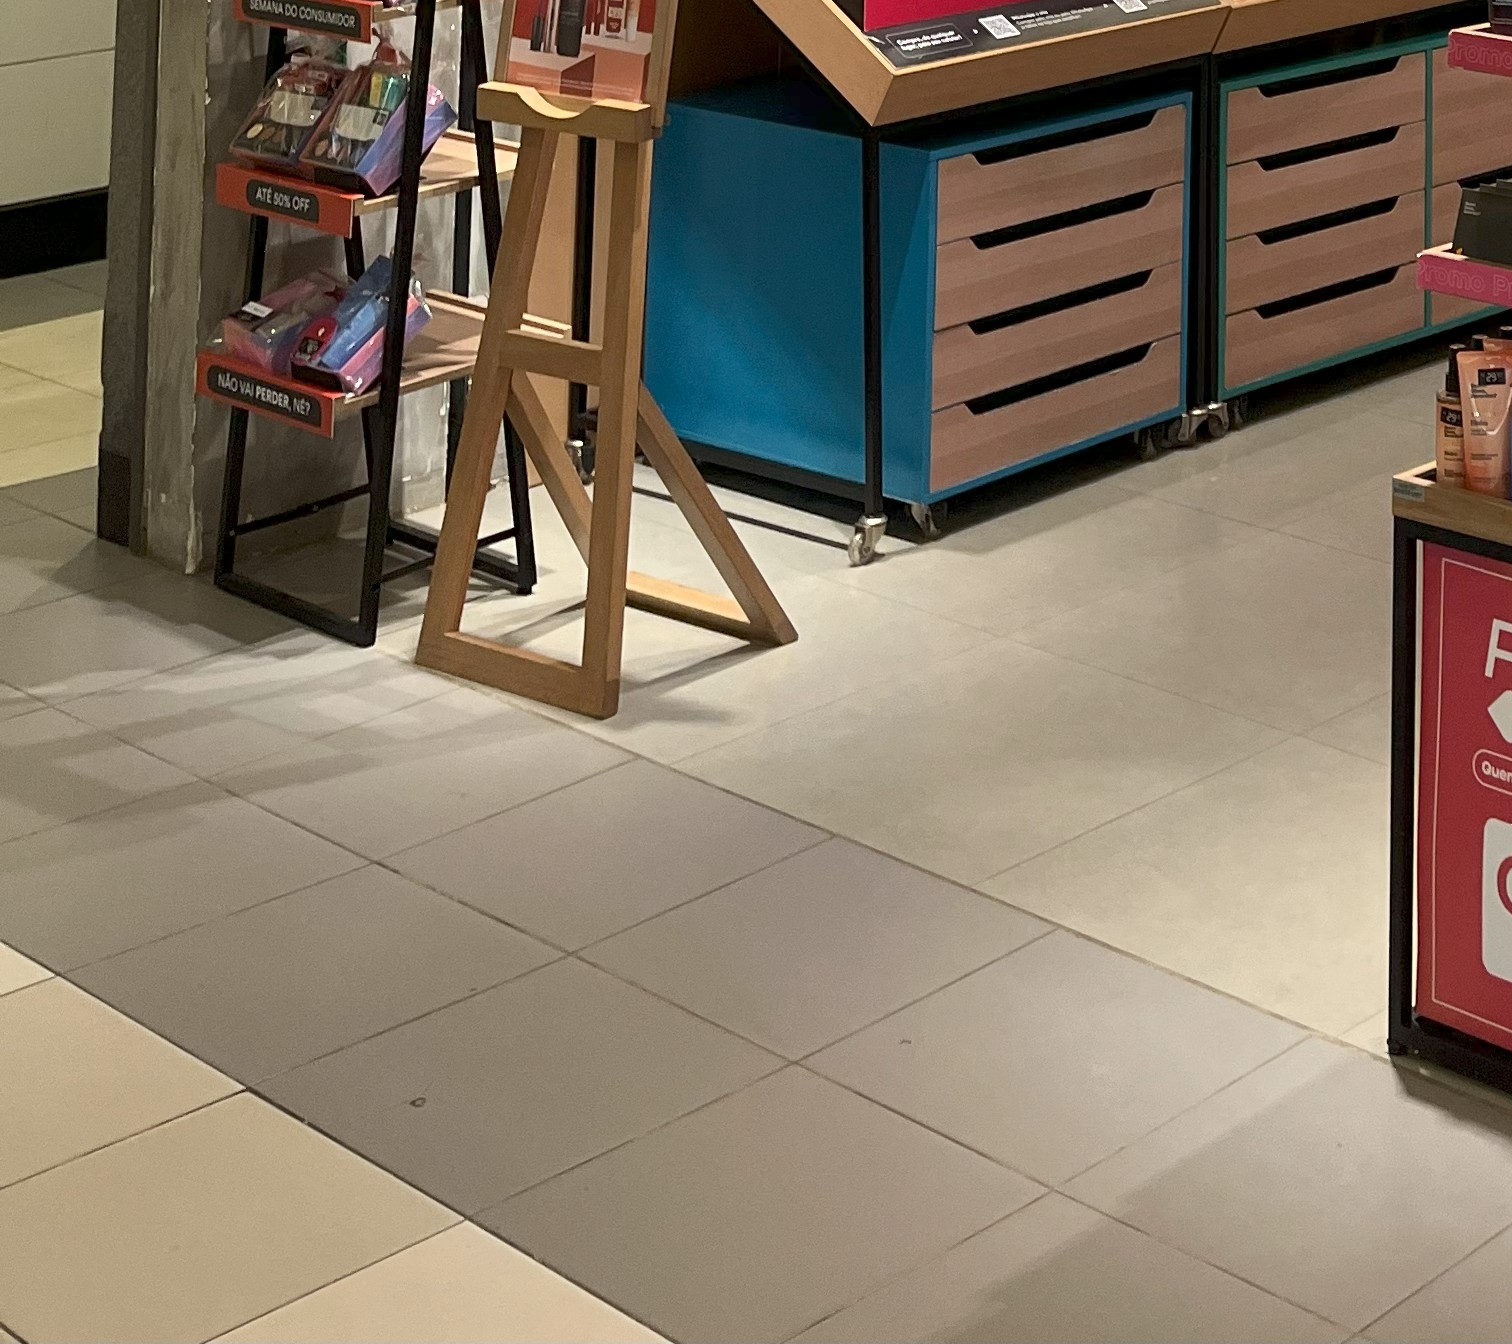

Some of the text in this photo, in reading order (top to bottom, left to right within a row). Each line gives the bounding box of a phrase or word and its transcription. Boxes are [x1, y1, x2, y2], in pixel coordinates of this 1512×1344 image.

[285, 3, 298, 18] DO
[300, 6, 356, 29] CONSUMIDOR
[255, 186, 310, 213] ATÉ 50% OFF
[217, 373, 239, 392] NÃO
[240, 380, 255, 398] VAI
[255, 385, 292, 412] PERDER,
